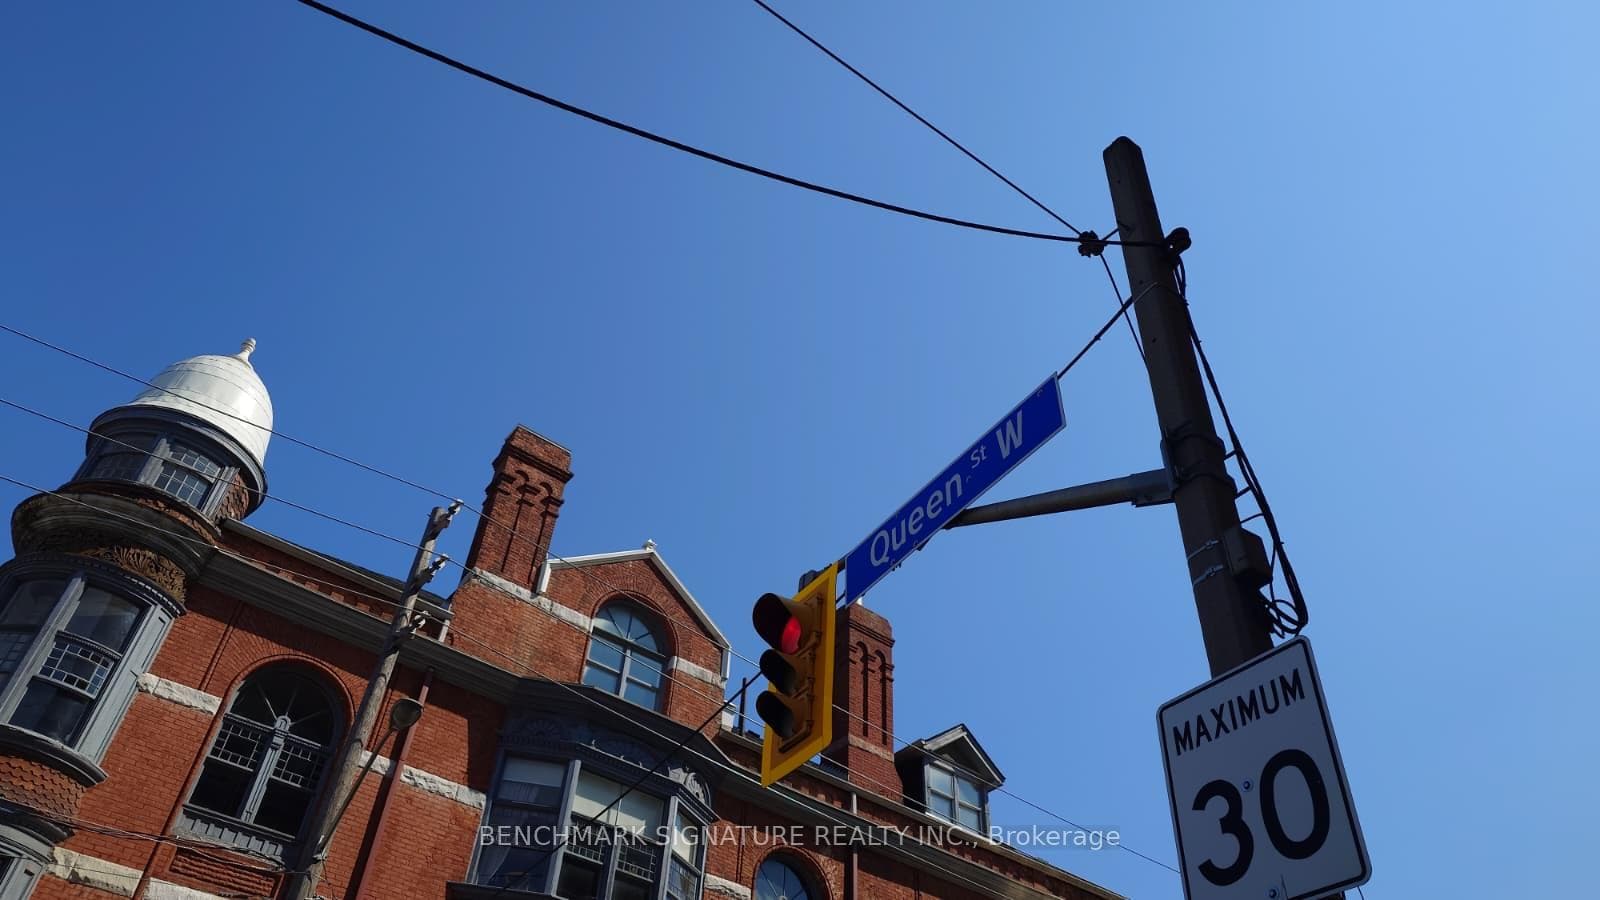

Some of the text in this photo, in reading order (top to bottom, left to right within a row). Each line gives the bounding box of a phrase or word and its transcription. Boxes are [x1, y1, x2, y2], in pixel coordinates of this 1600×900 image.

[870, 409, 1024, 567] Queen St W
[1172, 668, 1305, 756] MAXIMUM
[1192, 748, 1330, 887] 30
